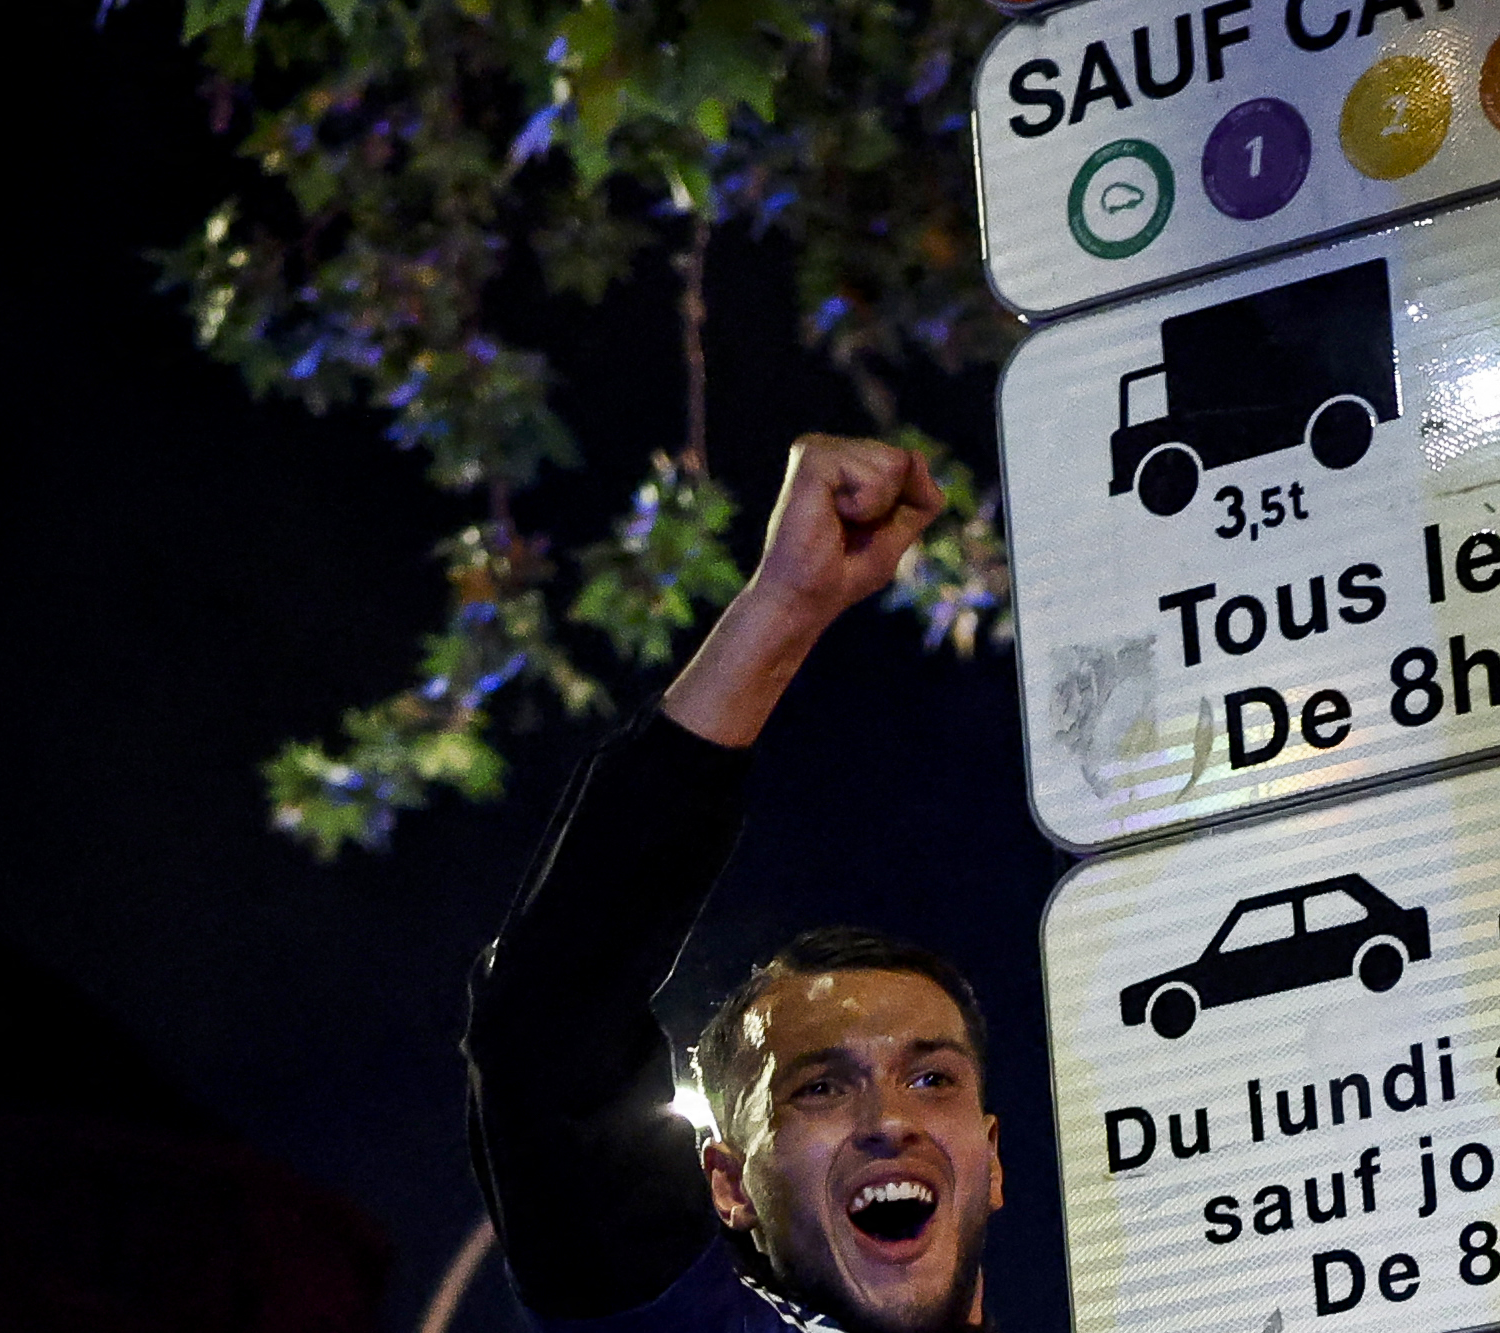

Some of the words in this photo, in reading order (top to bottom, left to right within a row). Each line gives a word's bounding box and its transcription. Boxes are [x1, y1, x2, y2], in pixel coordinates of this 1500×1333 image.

[1007, 2, 1254, 138] SAUF
[1244, 135, 1264, 179] 1
[1215, 482, 1308, 540] 3,5t
[1159, 563, 1386, 666] Tous
[1225, 687, 1351, 769] De
[1105, 1107, 1210, 1173] Du
[1248, 1037, 1454, 1142] lundi
[1204, 1147, 1380, 1244] sauf
[1313, 1249, 1419, 1316] De
